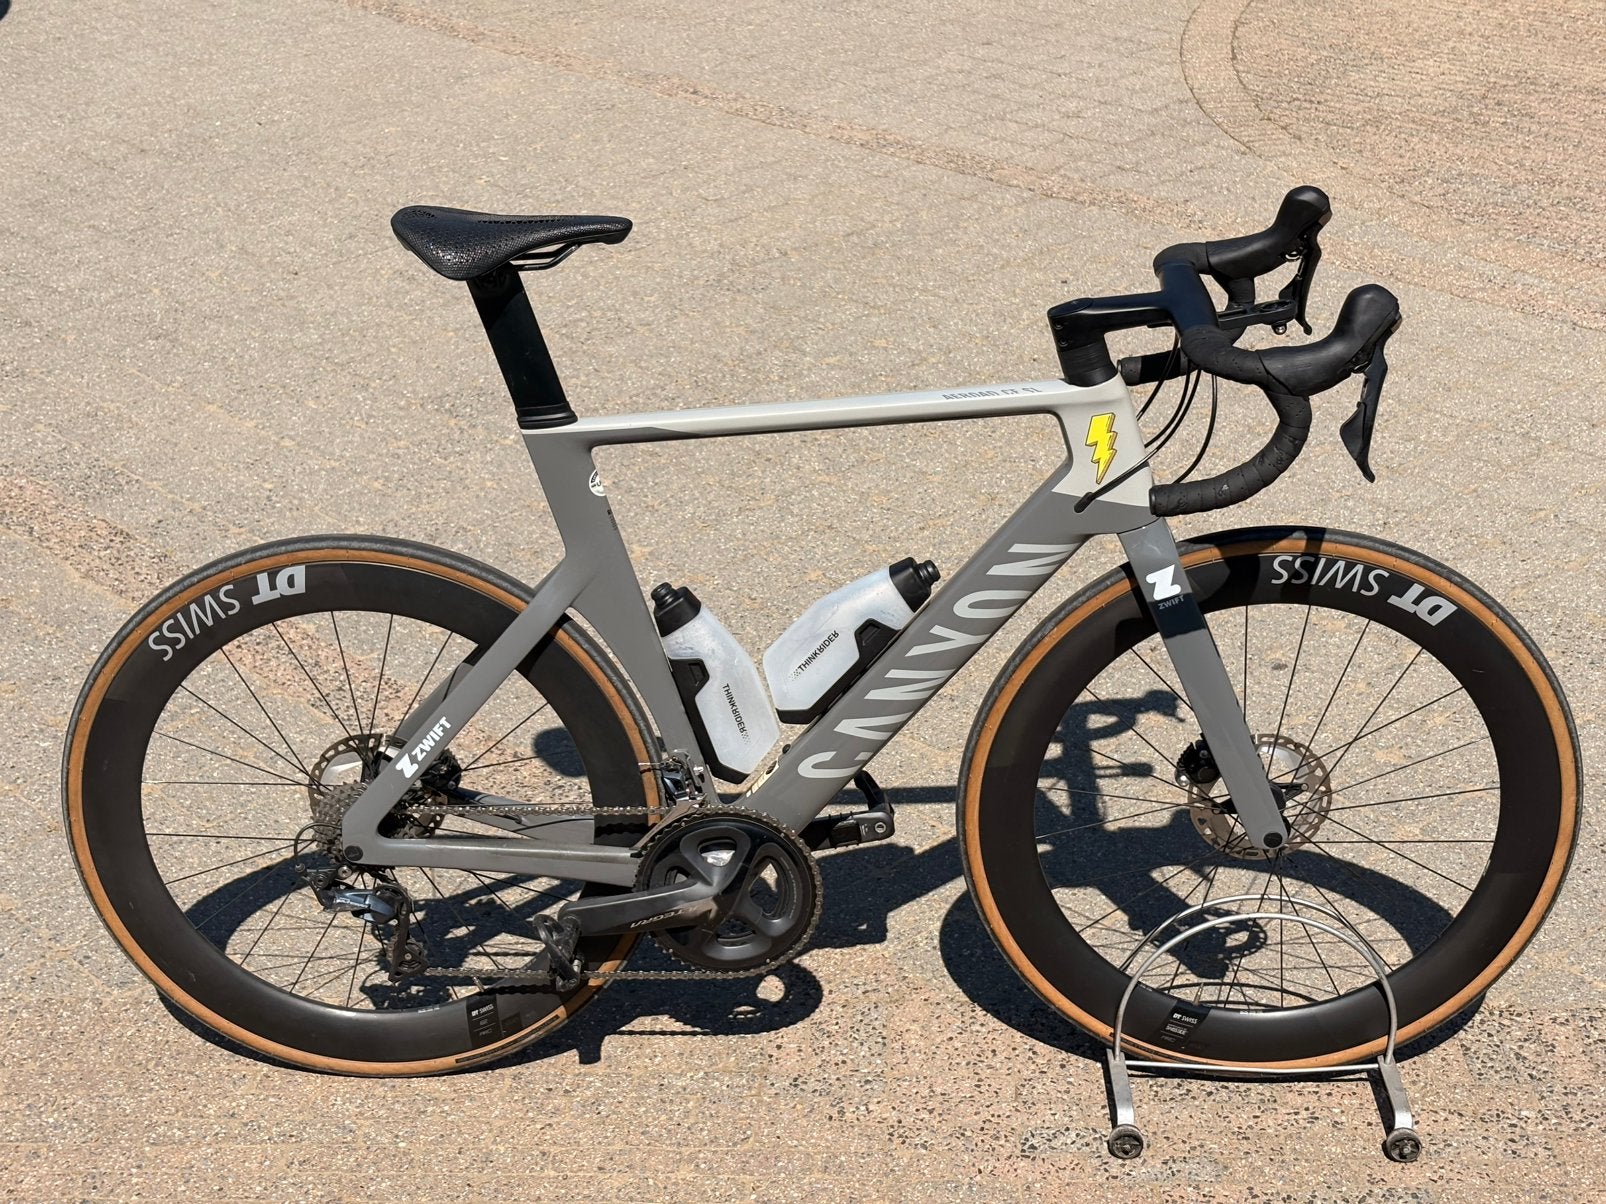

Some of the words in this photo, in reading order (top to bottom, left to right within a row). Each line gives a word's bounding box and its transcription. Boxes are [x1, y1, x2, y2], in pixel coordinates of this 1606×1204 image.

[942, 389, 1000, 400] AEROAD
[252, 565, 306, 605] DT
[1271, 555, 1390, 597] SWISS
[148, 584, 241, 662] SWISS
[1158, 595, 1184, 610] ZWIFT
[1387, 582, 1458, 627] DT
[798, 543, 1079, 778] CANYON
[411, 716, 452, 762] ZWIFT
[1172, 1012, 1182, 1020] DT
[1181, 1015, 1198, 1025] SWISS
